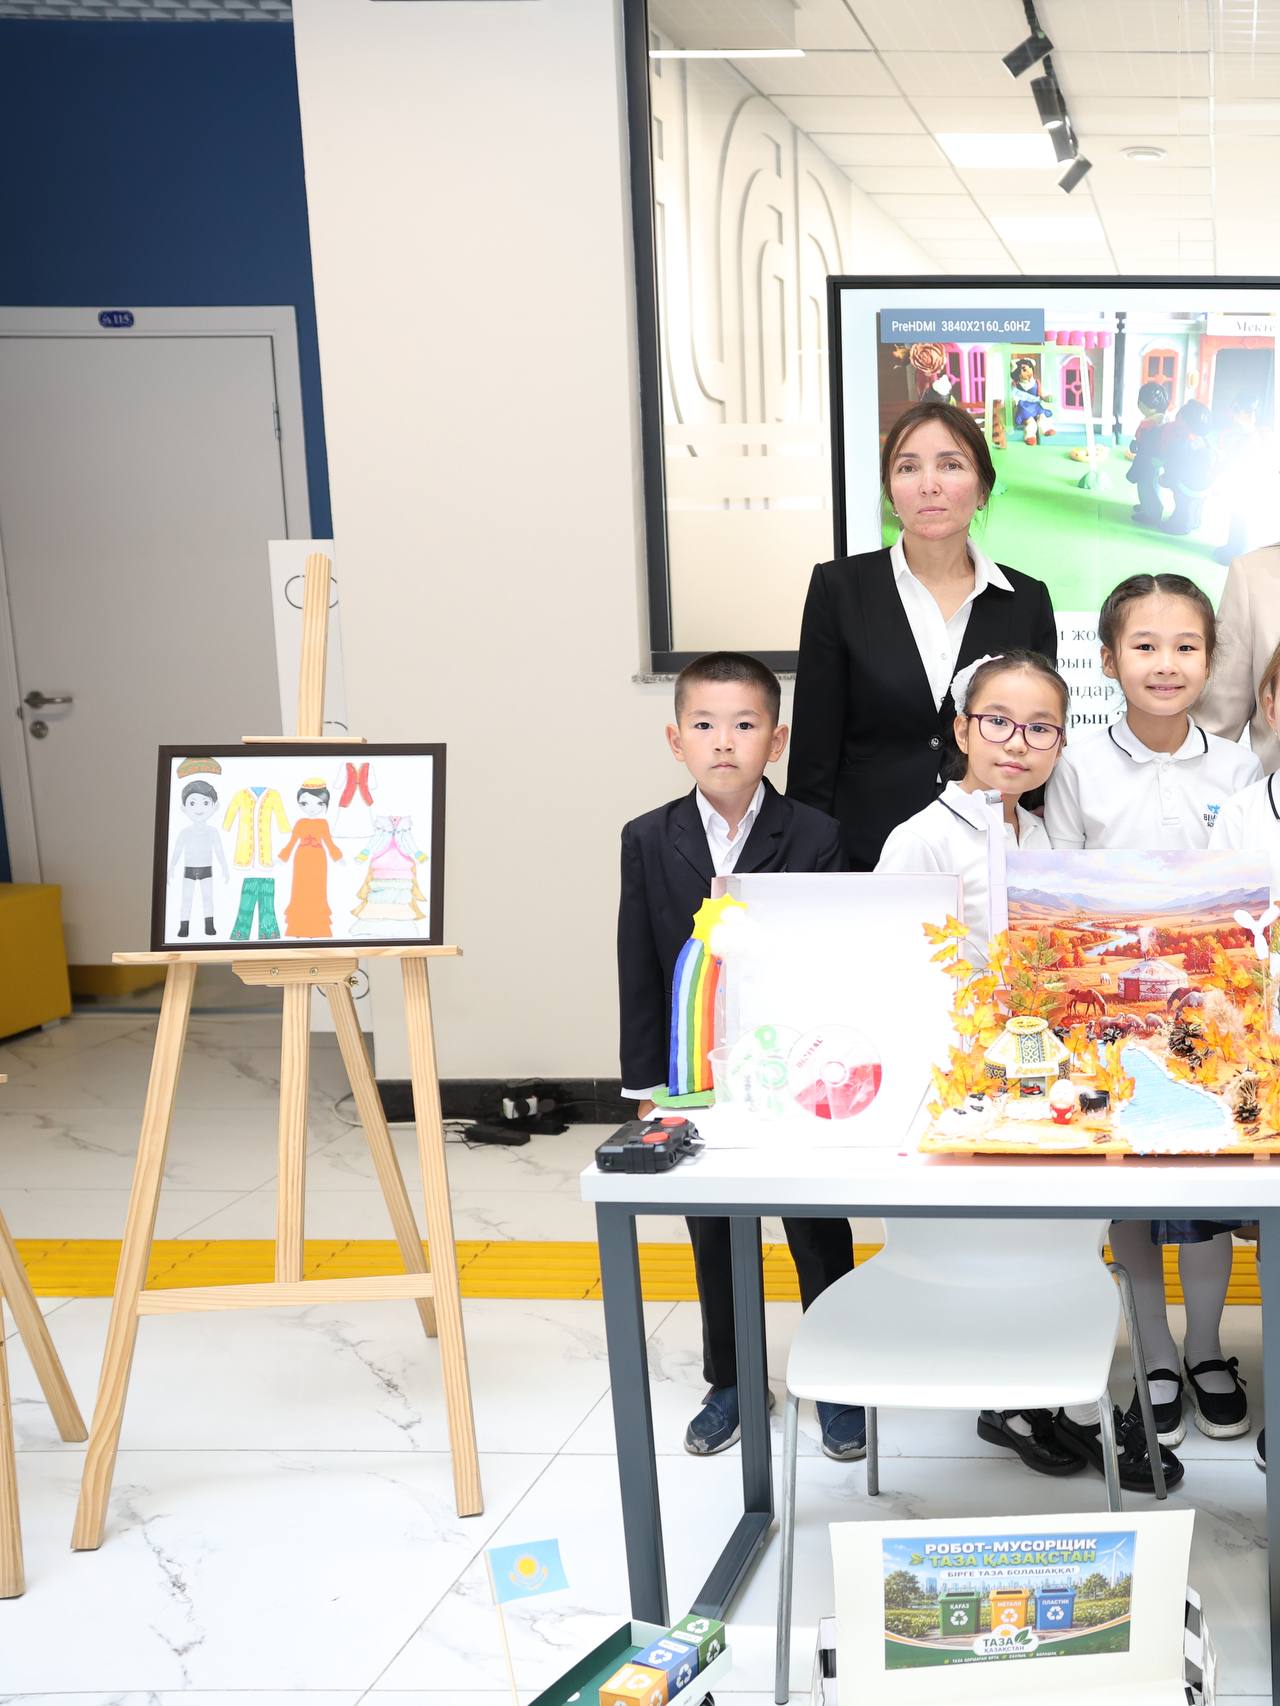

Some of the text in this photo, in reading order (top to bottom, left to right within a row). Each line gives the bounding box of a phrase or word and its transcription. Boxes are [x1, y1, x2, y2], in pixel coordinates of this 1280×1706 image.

[891, 320, 1031, 333] PreHDMI 3840X2160_60HZ
[1056, 657, 1092, 672] рын
[1070, 686, 1115, 700] ндар
[1070, 714, 1108, 728] рын
[925, 1539, 1097, 1554] РОБОТ-МУСОРЩИК
[930, 1550, 1096, 1568] ТАЗА ҚАЗАҚСТАН
[979, 1569, 1003, 1577] ТАЗА
[983, 1637, 1014, 1648] ТАЗА
